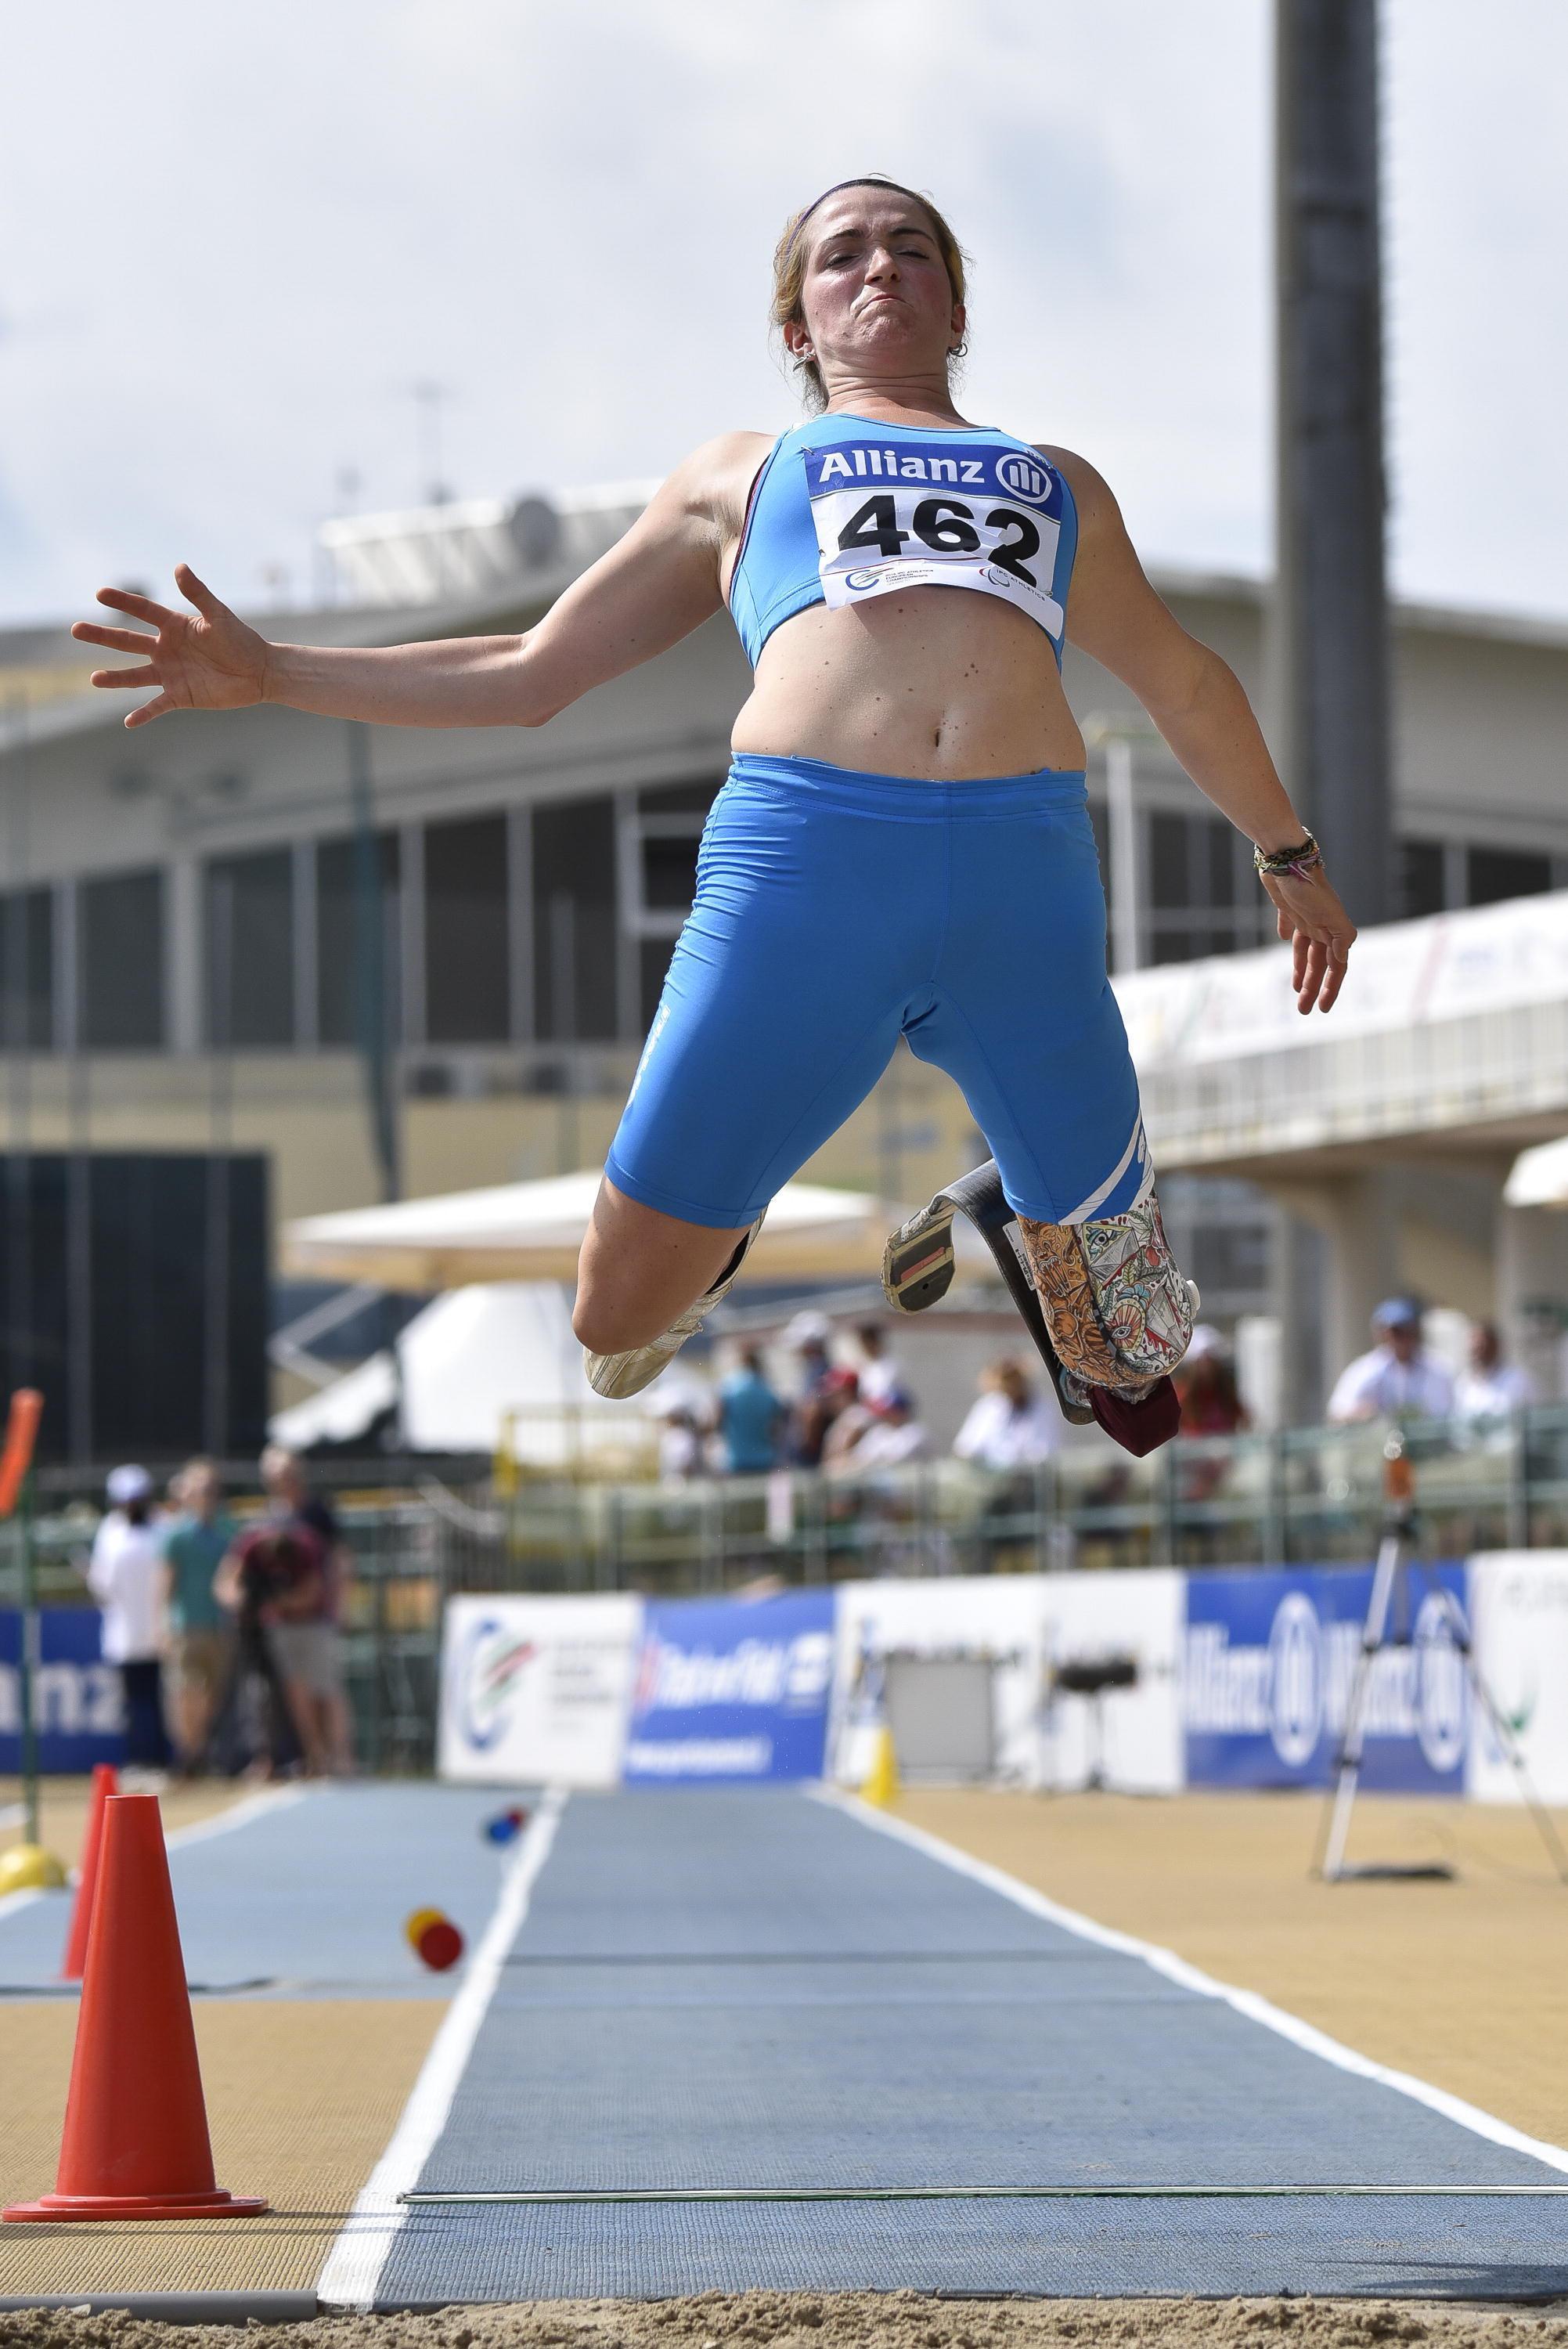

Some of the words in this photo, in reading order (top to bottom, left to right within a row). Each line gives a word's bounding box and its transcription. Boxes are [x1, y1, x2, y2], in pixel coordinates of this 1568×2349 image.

[819, 449, 985, 483] Allianz
[838, 495, 1040, 588] 462
[997, 568, 1008, 578] IPC
[1011, 576, 1046, 601] ATHLETICS
